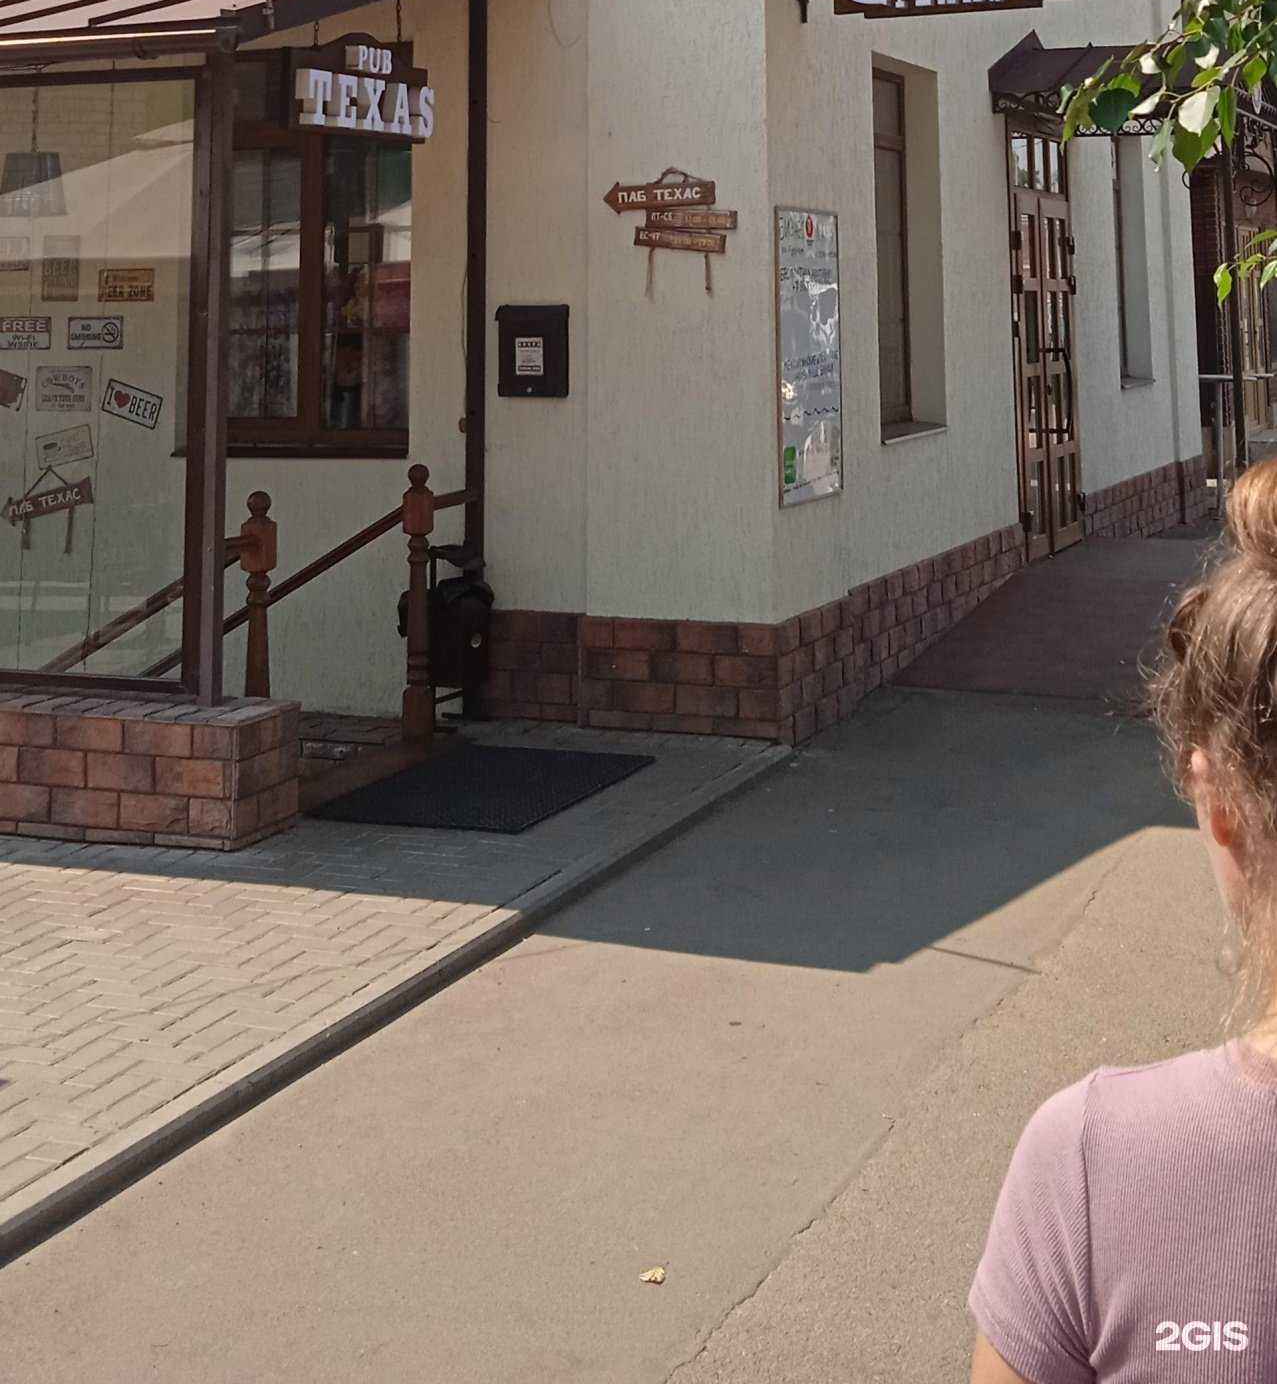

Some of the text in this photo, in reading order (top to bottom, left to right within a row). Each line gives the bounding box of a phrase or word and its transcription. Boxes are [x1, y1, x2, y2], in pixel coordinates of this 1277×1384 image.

[355, 45, 393, 74] PUB
[302, 68, 434, 138] TEXAS
[617, 186, 702, 204] ПАБ ТЕХАС
[2, 319, 47, 332] FREE
[106, 386, 158, 422] I BEER
[38, 488, 81, 507] ТЕХАС
